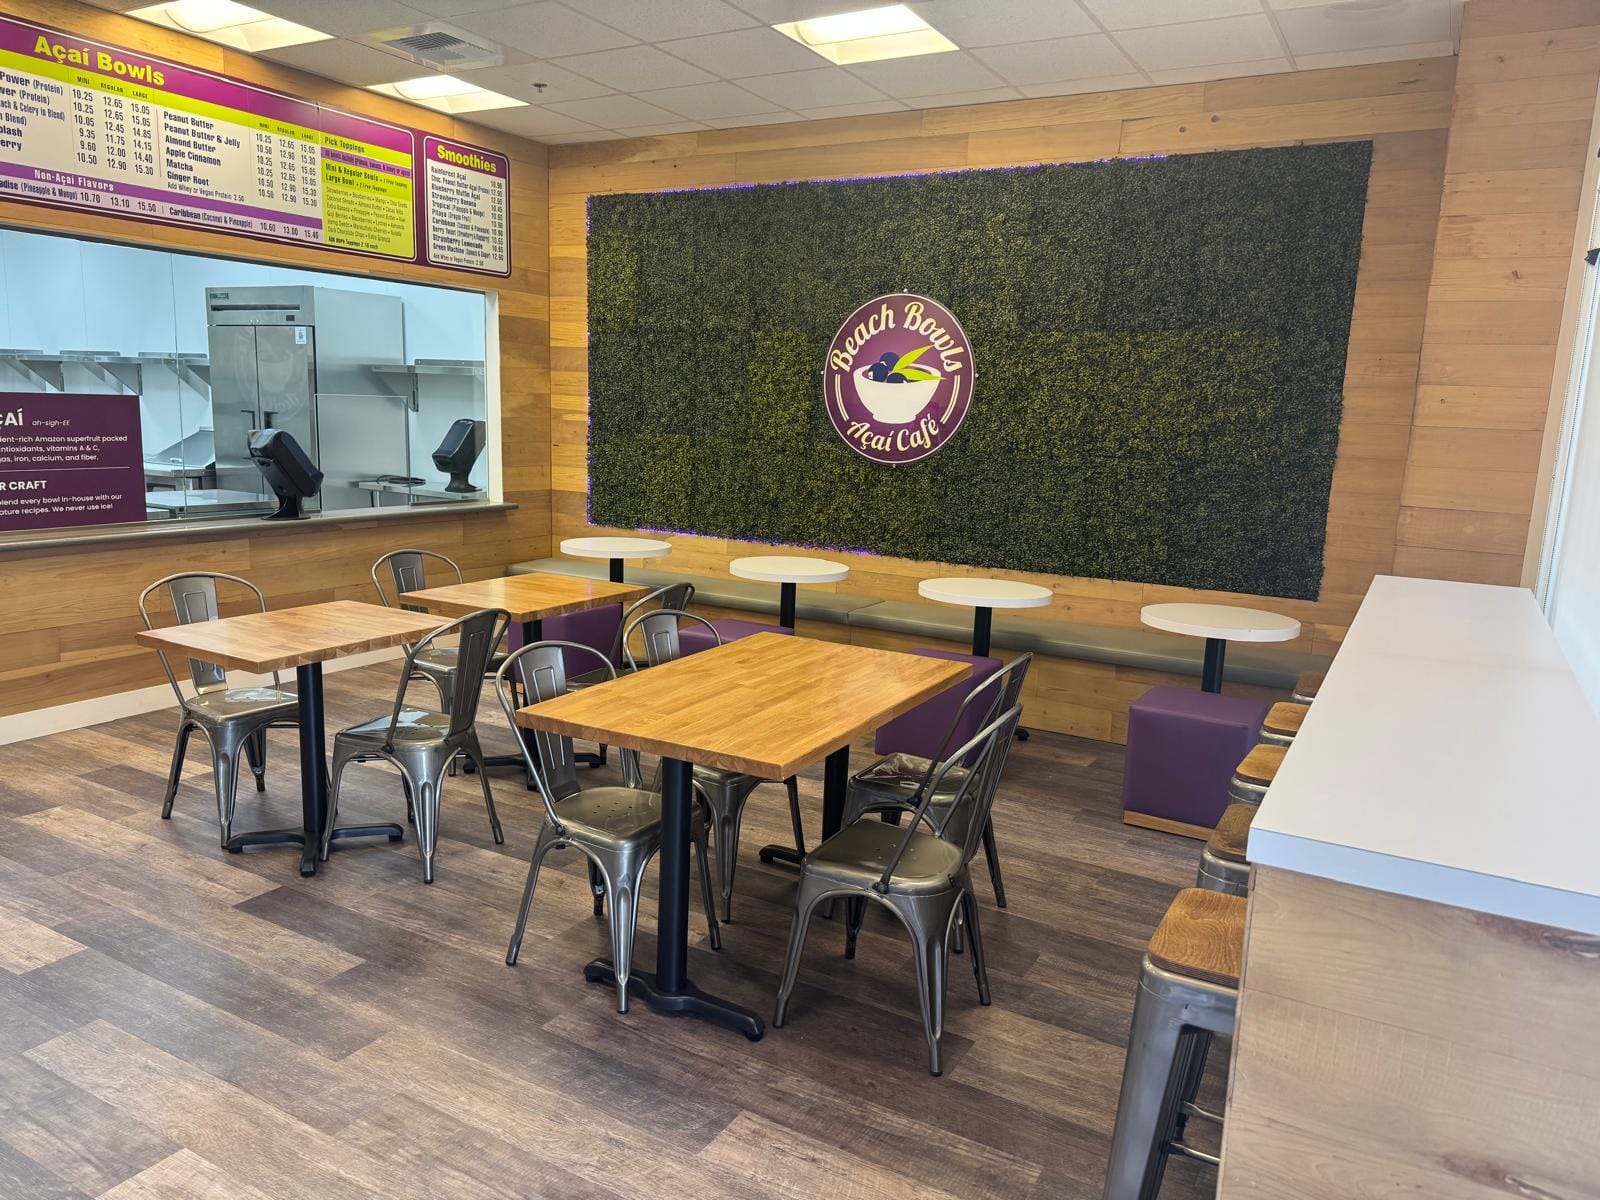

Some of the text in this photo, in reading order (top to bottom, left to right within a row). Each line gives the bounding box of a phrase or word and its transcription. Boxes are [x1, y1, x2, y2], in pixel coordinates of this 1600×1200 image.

[34, 35, 165, 86] Açaí Bowls
[0, 71, 149, 115] Power (Protein) 10.25 12.65 15.05
[77, 76, 89, 84] MINI
[101, 83, 123, 92] REGULAR
[19, 90, 150, 127] (Protein) 10.25 12.65 15.05
[14, 101, 17, 110] &
[20, 102, 38, 116] Celery
[48, 109, 65, 121] Blend)
[75, 115, 94, 127] 10.05
[105, 121, 124, 133] 12.45
[133, 128, 151, 139] 14.85
[164, 111, 188, 124] Peanut
[191, 118, 214, 130] Butter
[256, 133, 271, 144] 10.25
[6, 113, 151, 151] Blend) 9.35 11.75 14.15
[164, 123, 189, 136] Peanut
[192, 130, 215, 141] Butter
[224, 137, 240, 148] Jelly
[80, 140, 152, 163] 9.60 12.00 14.40
[165, 135, 191, 147] Almond
[193, 141, 216, 153] Butter
[257, 156, 272, 166] 10.25
[325, 136, 364, 153] Pick Toppings
[77, 152, 97, 164] 10.50
[107, 158, 126, 170] 12.90
[135, 164, 153, 175] 15.30
[166, 147, 185, 158] Apple
[188, 151, 221, 166] Cinnamon
[258, 167, 273, 177] 10.25
[166, 159, 193, 171] Matcha
[437, 145, 496, 172] Smoothies
[35, 169, 114, 191] Non-Açaí Flavors
[167, 171, 191, 182] Ginger
[193, 176, 209, 186] Root
[326, 174, 340, 184] Large
[342, 177, 354, 186] Bowl
[344, 167, 362, 178] Regular
[364, 172, 378, 181] Bowls
[21, 182, 50, 197] (Pineapple
[52, 187, 56, 196] &
[58, 188, 77, 201] Mango)
[80, 192, 100, 203] 10.70
[110, 197, 129, 208] 13.10
[138, 201, 156, 212] 15.50
[169, 207, 201, 219] Caribbean
[199, 188, 214, 197] Vegan
[432, 192, 459, 204] Strawberry
[432, 200, 450, 212] Tropical
[433, 234, 460, 246] Strawberry
[830, 301, 965, 372] Beach Bowls
[32, 420, 70, 428] ah-sigh-EE
[847, 414, 939, 451] Açaí Café
[67, 435, 101, 443] superfruit
[102, 435, 127, 443] packed
[32, 454, 63, 462] calcium,
[9, 480, 47, 490] CRAFT
[62, 494, 93, 502] in-house
[22, 507, 50, 515] recipes.
